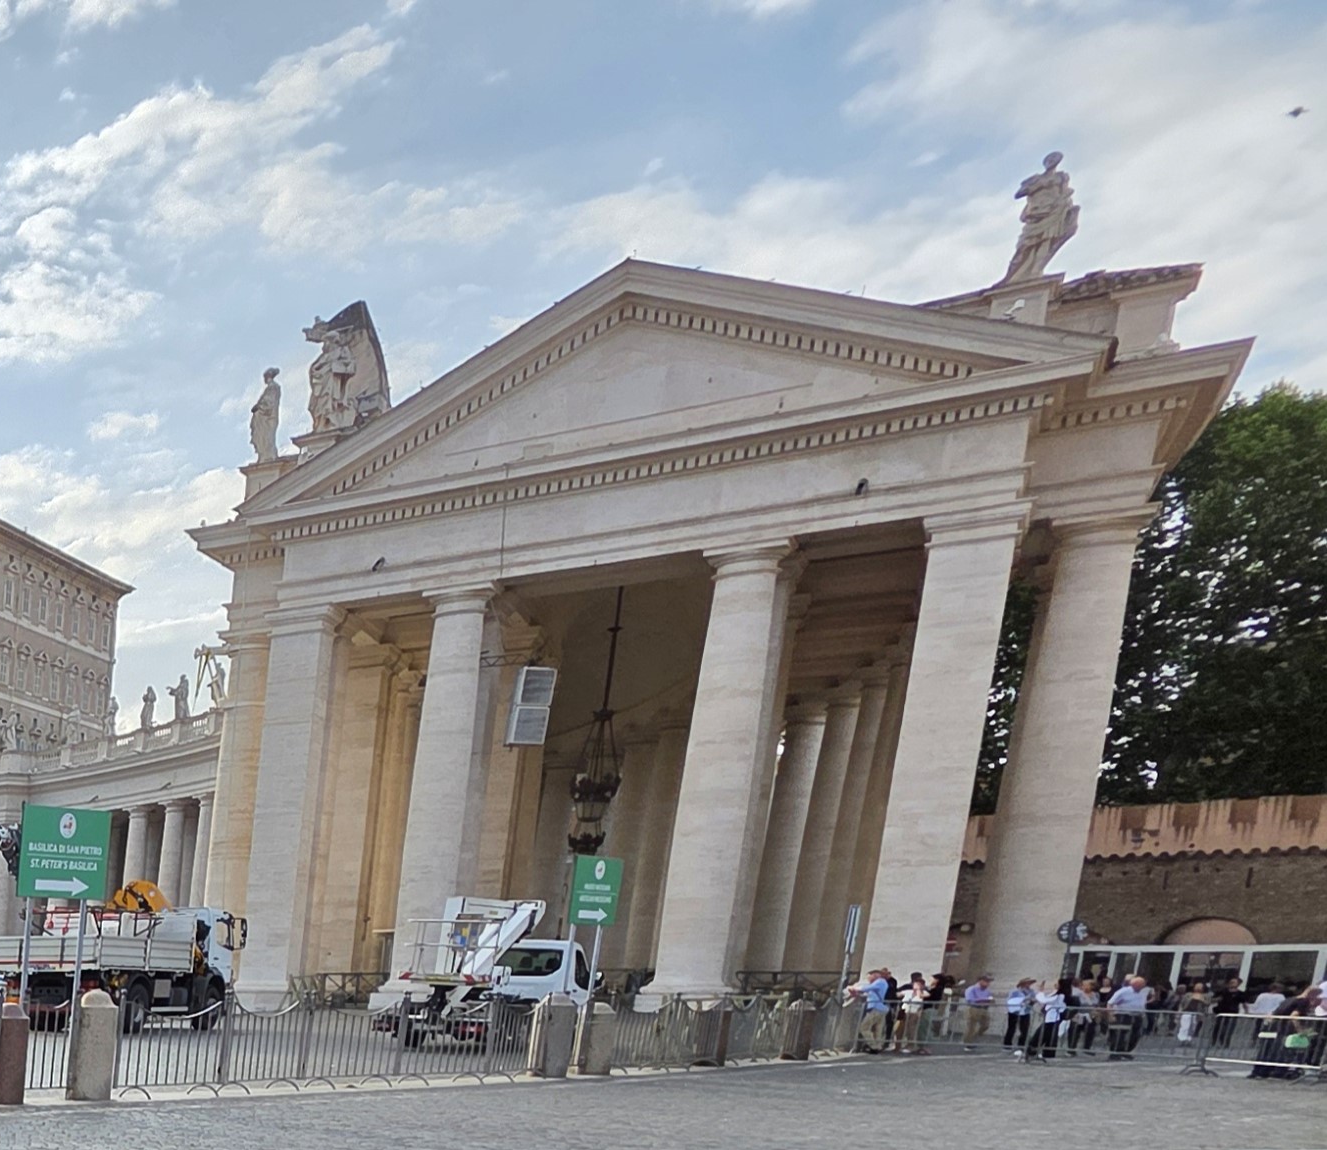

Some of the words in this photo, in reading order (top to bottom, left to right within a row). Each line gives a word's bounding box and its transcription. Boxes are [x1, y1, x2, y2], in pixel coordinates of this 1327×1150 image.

[28, 842, 58, 852] BASILICA
[58, 844, 65, 853] DI
[66, 844, 79, 854] SAN
[80, 845, 103, 856] PIETRO
[30, 858, 40, 868] ST.
[40, 858, 68, 870] PETER'S
[68, 860, 98, 871] BASILICA
